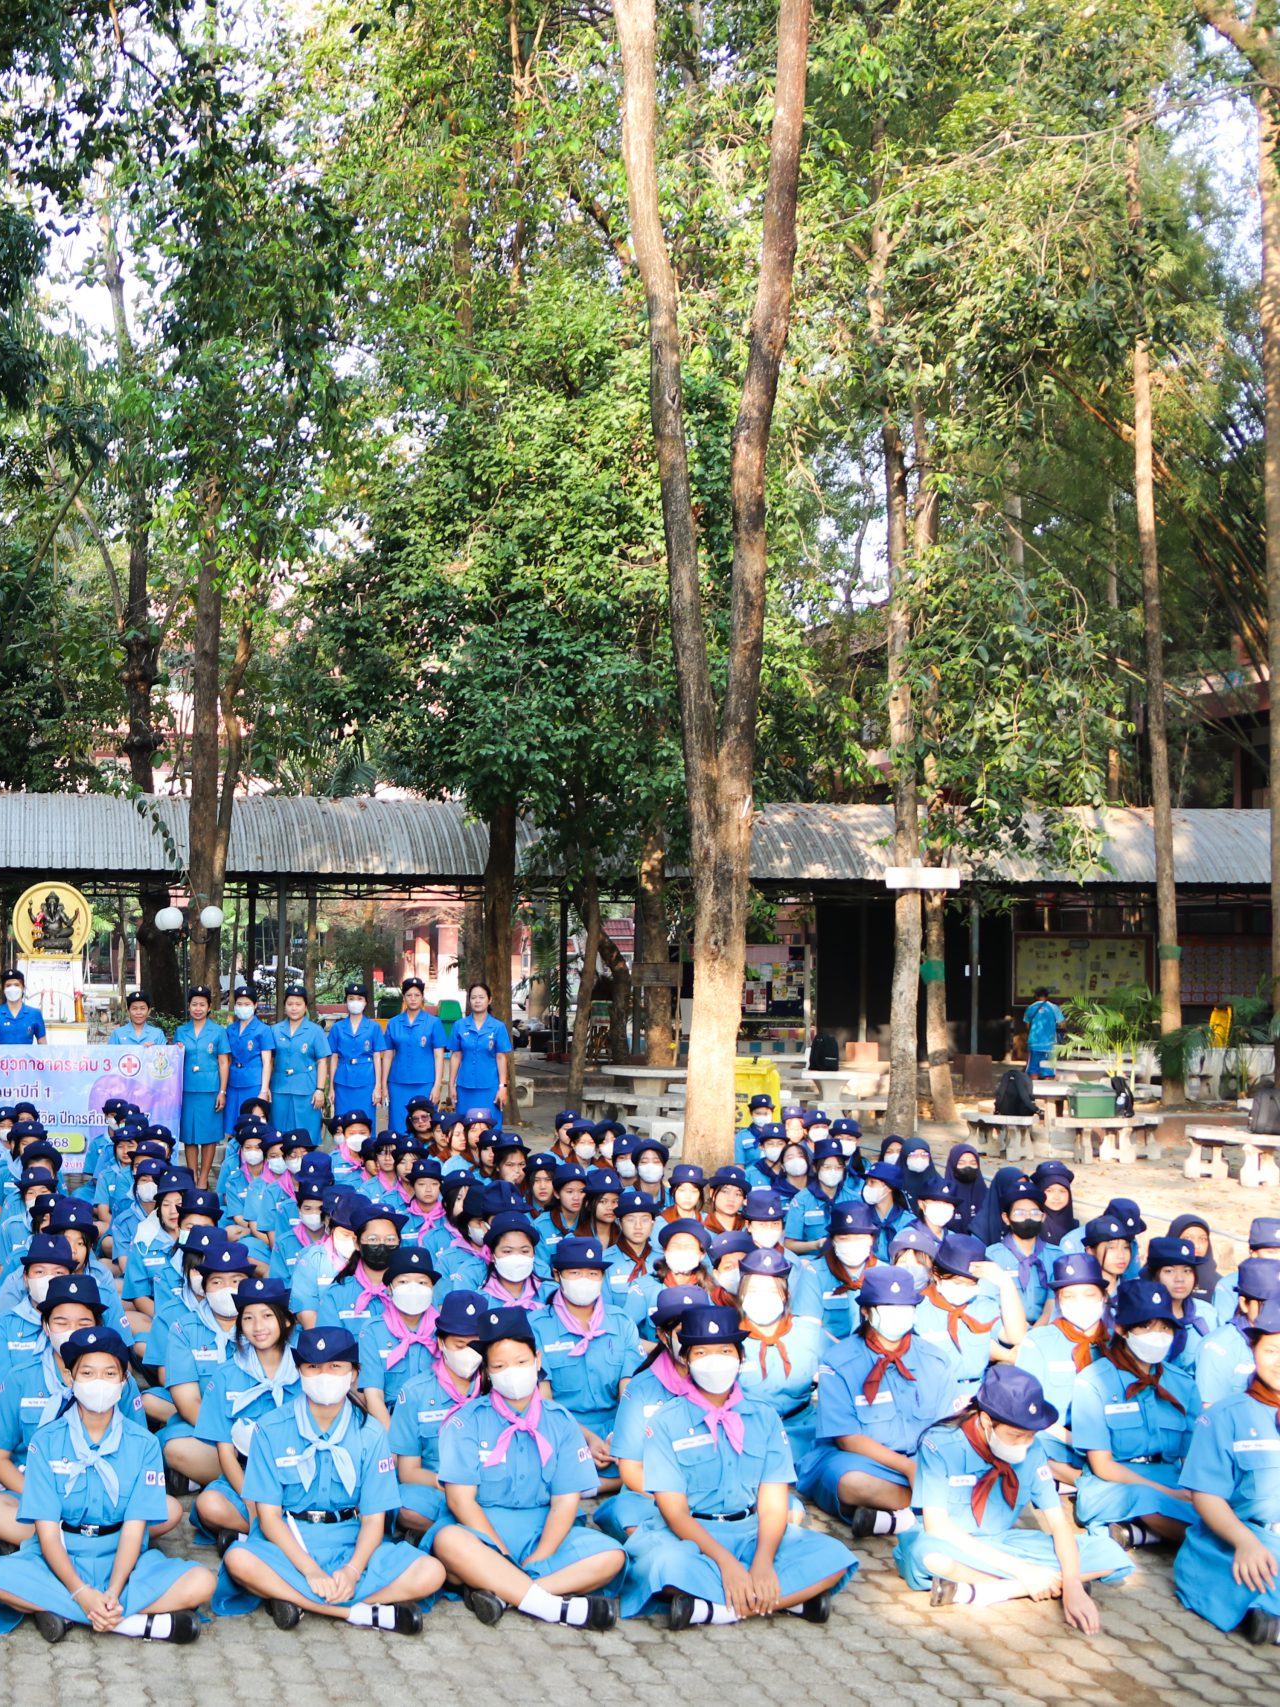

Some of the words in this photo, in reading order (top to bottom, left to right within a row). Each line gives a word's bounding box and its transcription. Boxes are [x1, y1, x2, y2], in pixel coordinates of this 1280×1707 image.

[103, 1058, 111, 1072] 3
[44, 1087, 51, 1098] 1
[47, 1137, 69, 1148] 568
